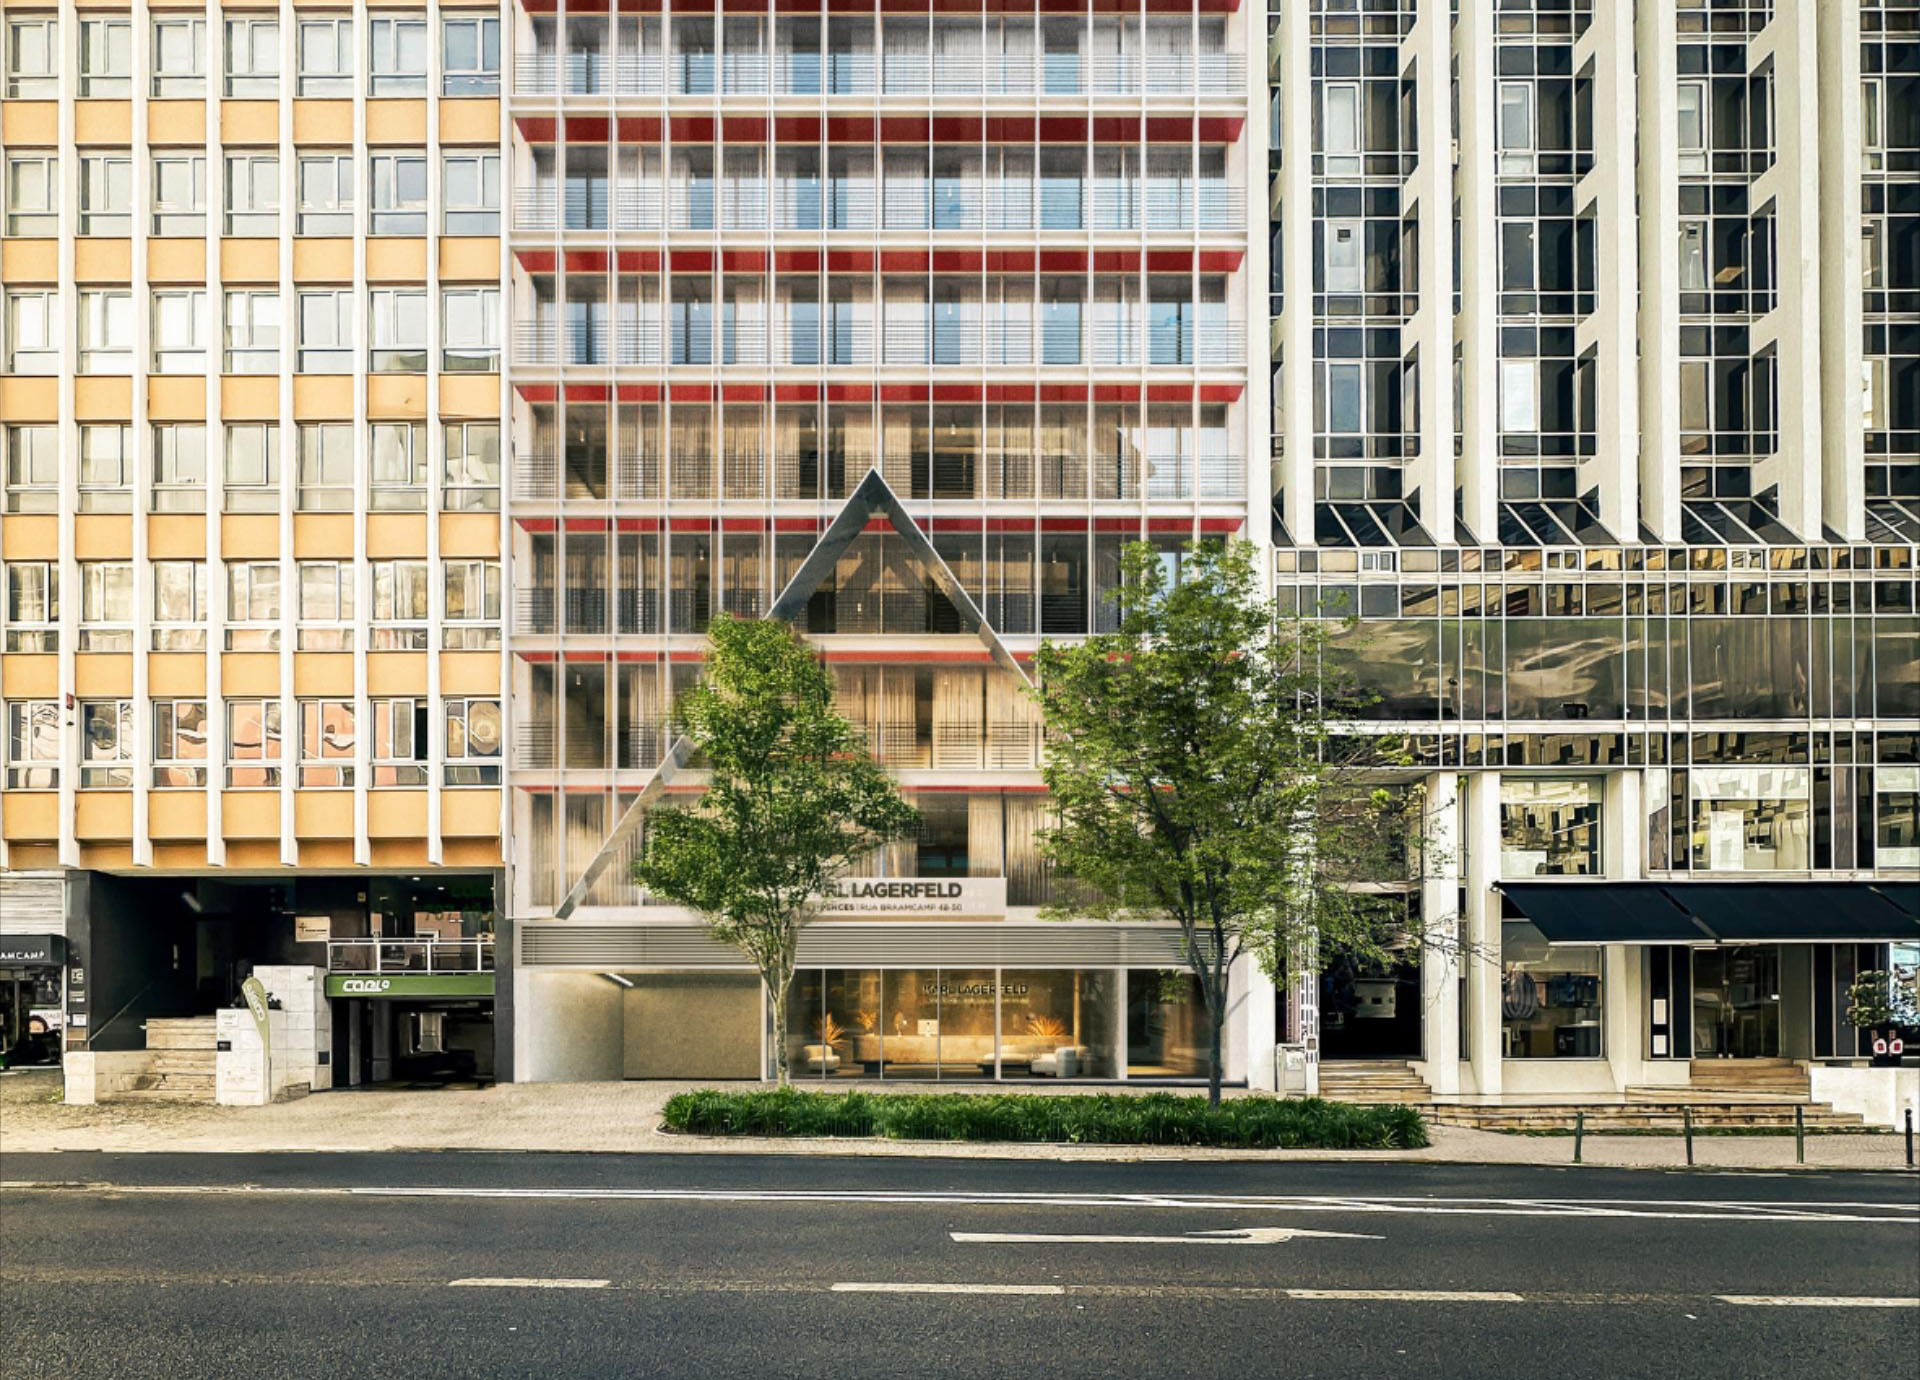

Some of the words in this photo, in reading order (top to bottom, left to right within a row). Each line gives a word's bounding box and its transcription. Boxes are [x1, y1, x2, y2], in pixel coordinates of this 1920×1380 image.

[852, 882, 962, 898] LAGERFELD
[0, 951, 45, 960] AMCAMP
[958, 984, 1029, 994] LAGERFELD
